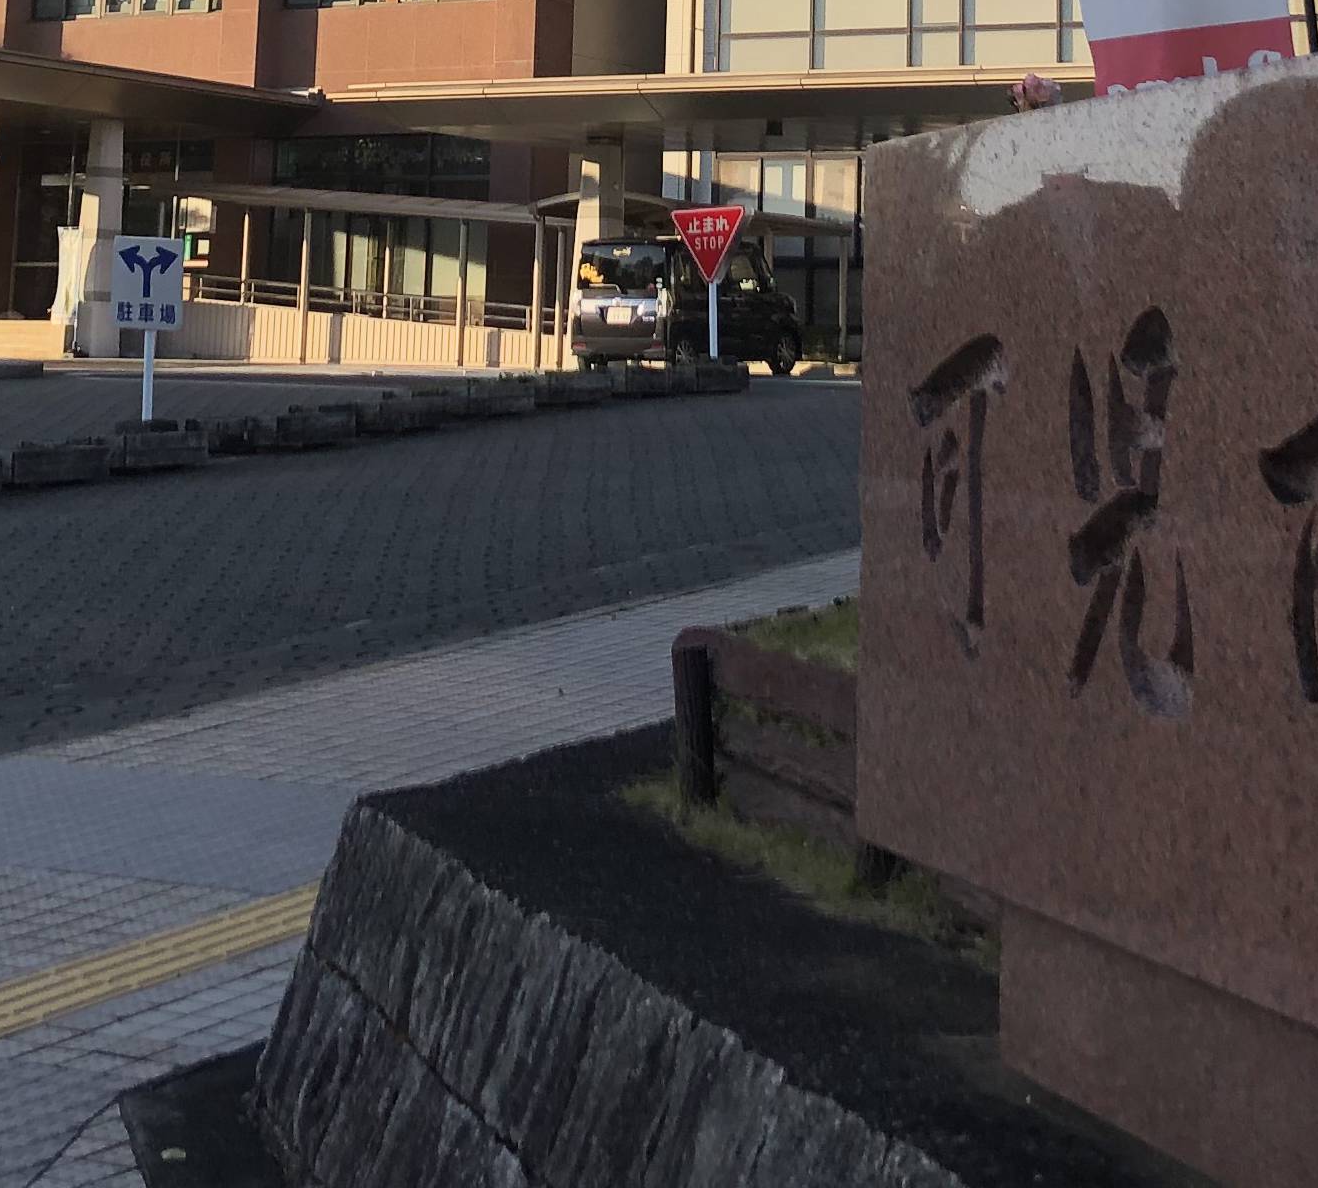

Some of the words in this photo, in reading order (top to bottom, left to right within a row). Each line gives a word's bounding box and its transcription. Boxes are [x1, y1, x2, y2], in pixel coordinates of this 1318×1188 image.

[686, 215, 730, 234] 止まれ
[694, 236, 725, 250] STOP
[117, 301, 176, 324] 駐車場
